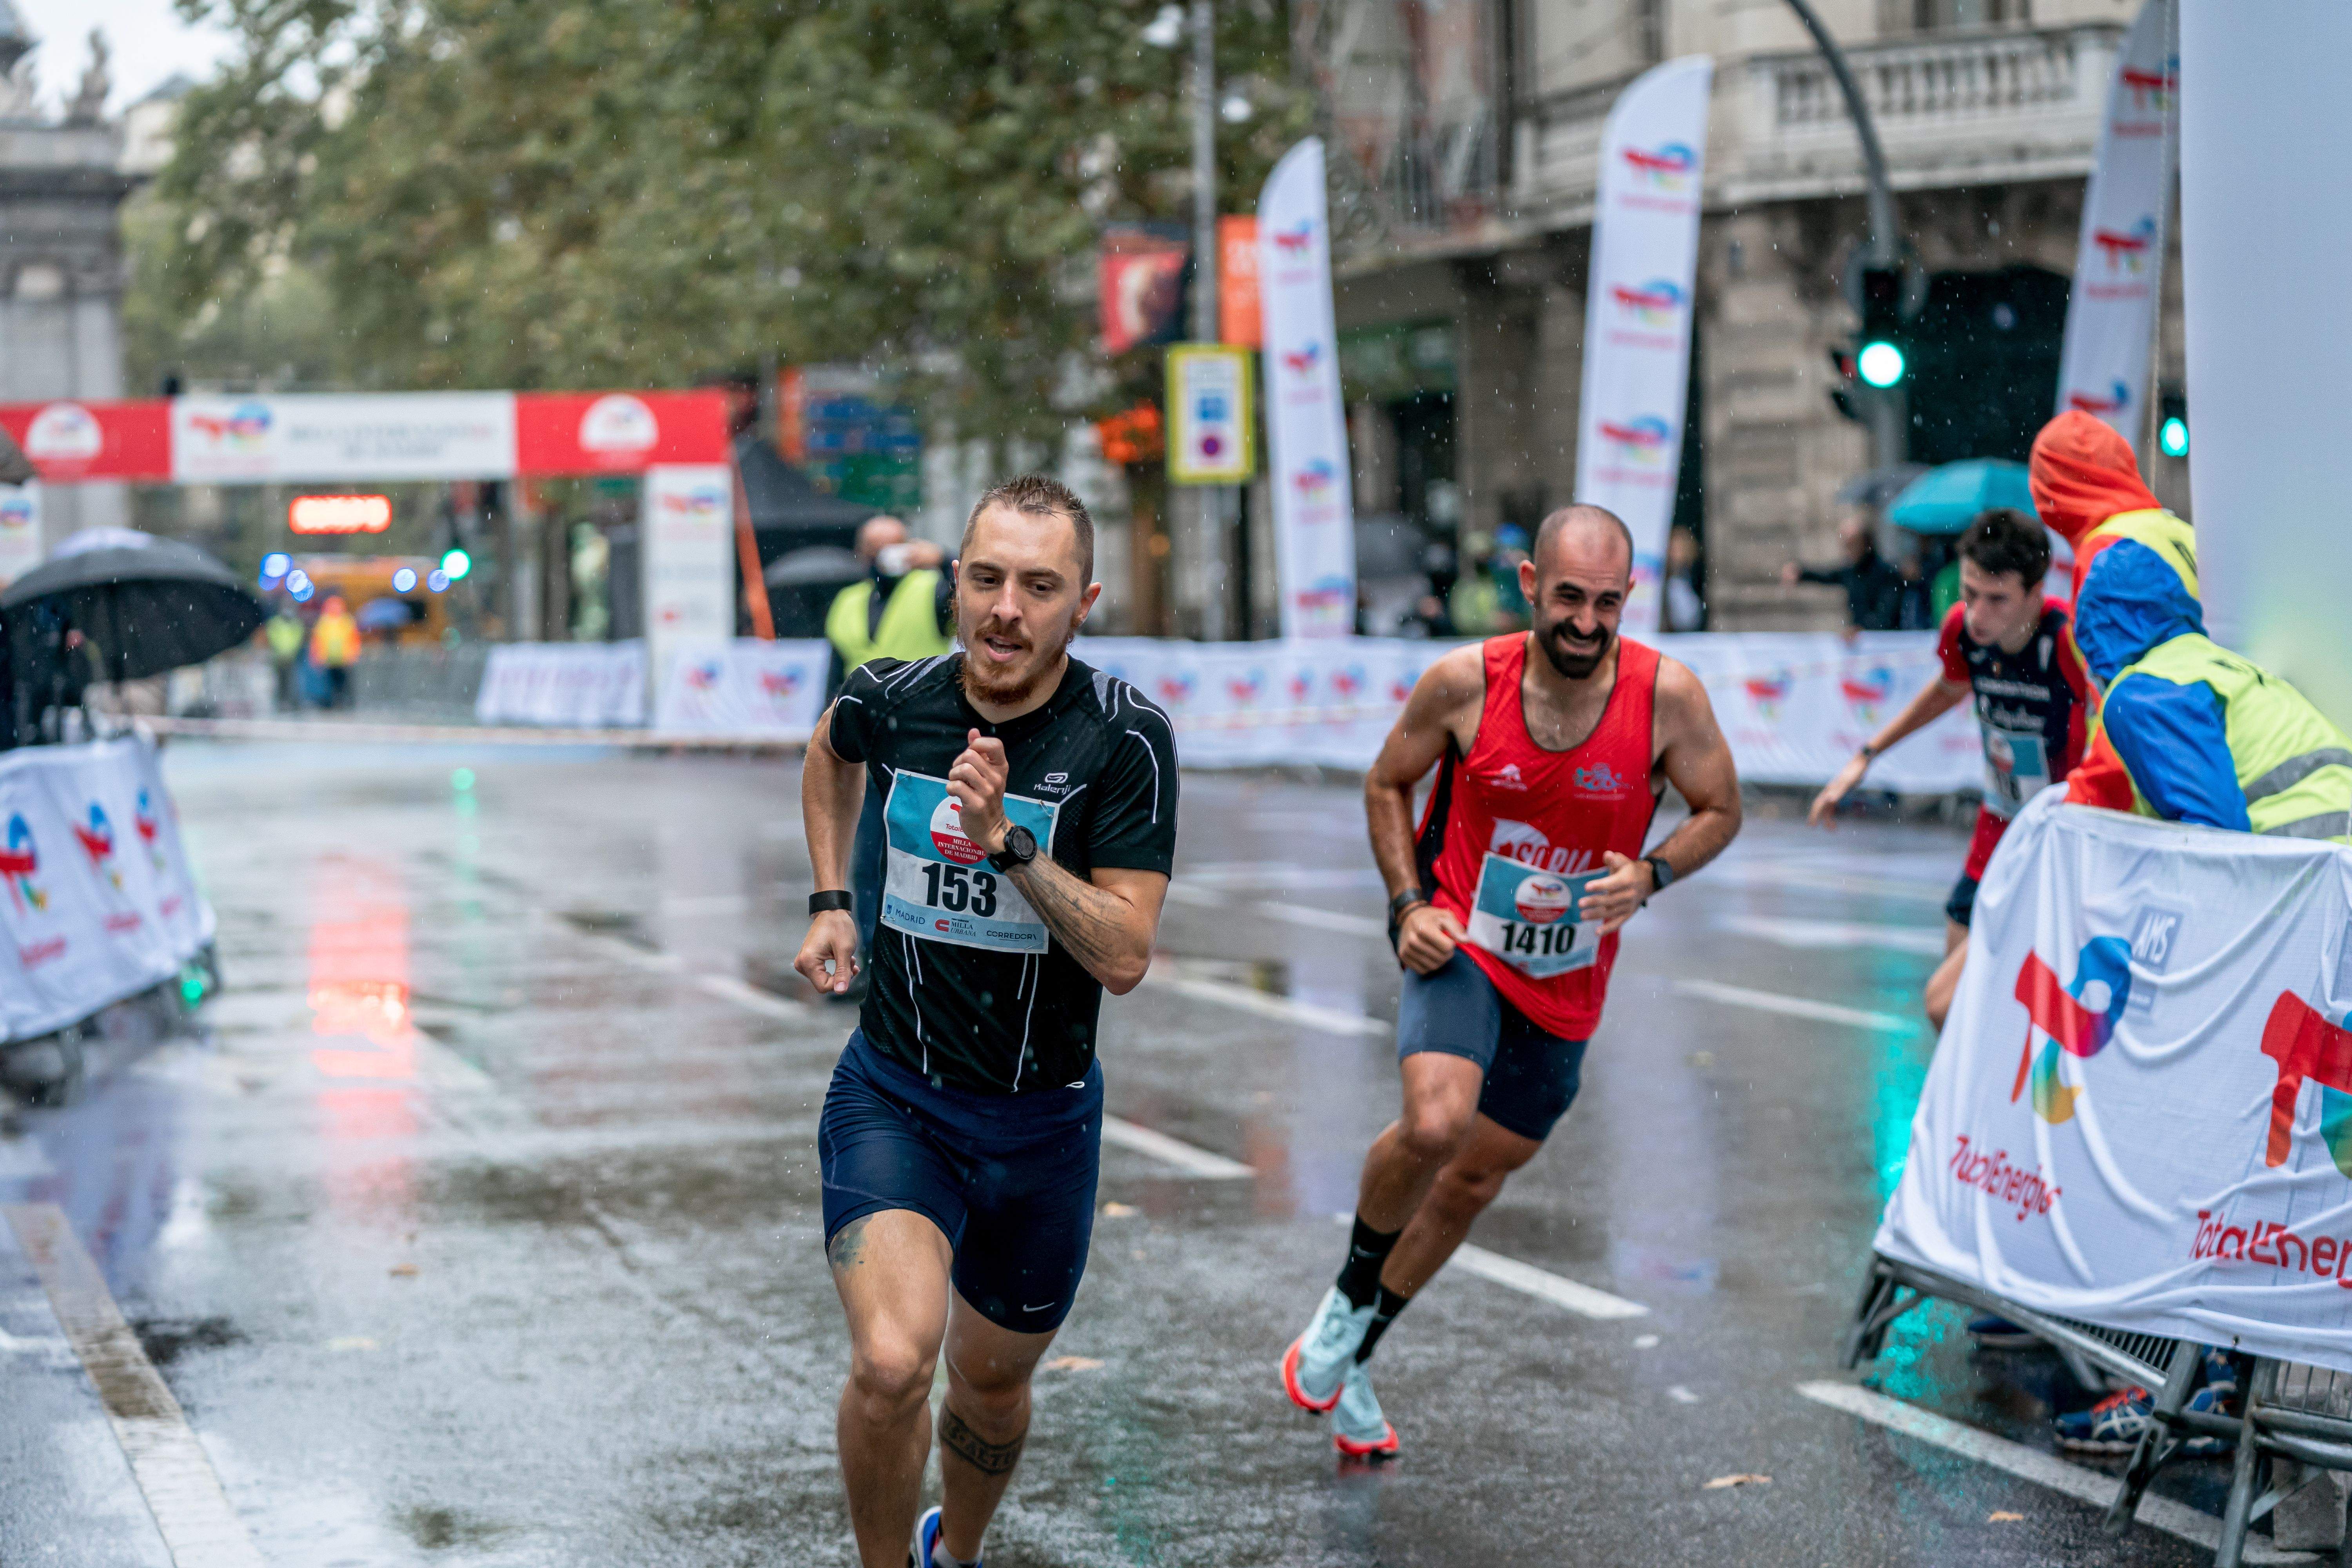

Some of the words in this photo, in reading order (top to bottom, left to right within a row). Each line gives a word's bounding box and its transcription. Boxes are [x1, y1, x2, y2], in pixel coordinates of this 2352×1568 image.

[1034, 784, 1071, 795] Kalenji
[953, 838, 971, 847] MILLA
[954, 851, 978, 860] MADRID
[922, 862, 997, 918] 153
[895, 908, 926, 925] MADRID
[951, 921, 973, 930] MILLA
[950, 927, 976, 937] URBANA
[1501, 922, 1577, 955] 1410
